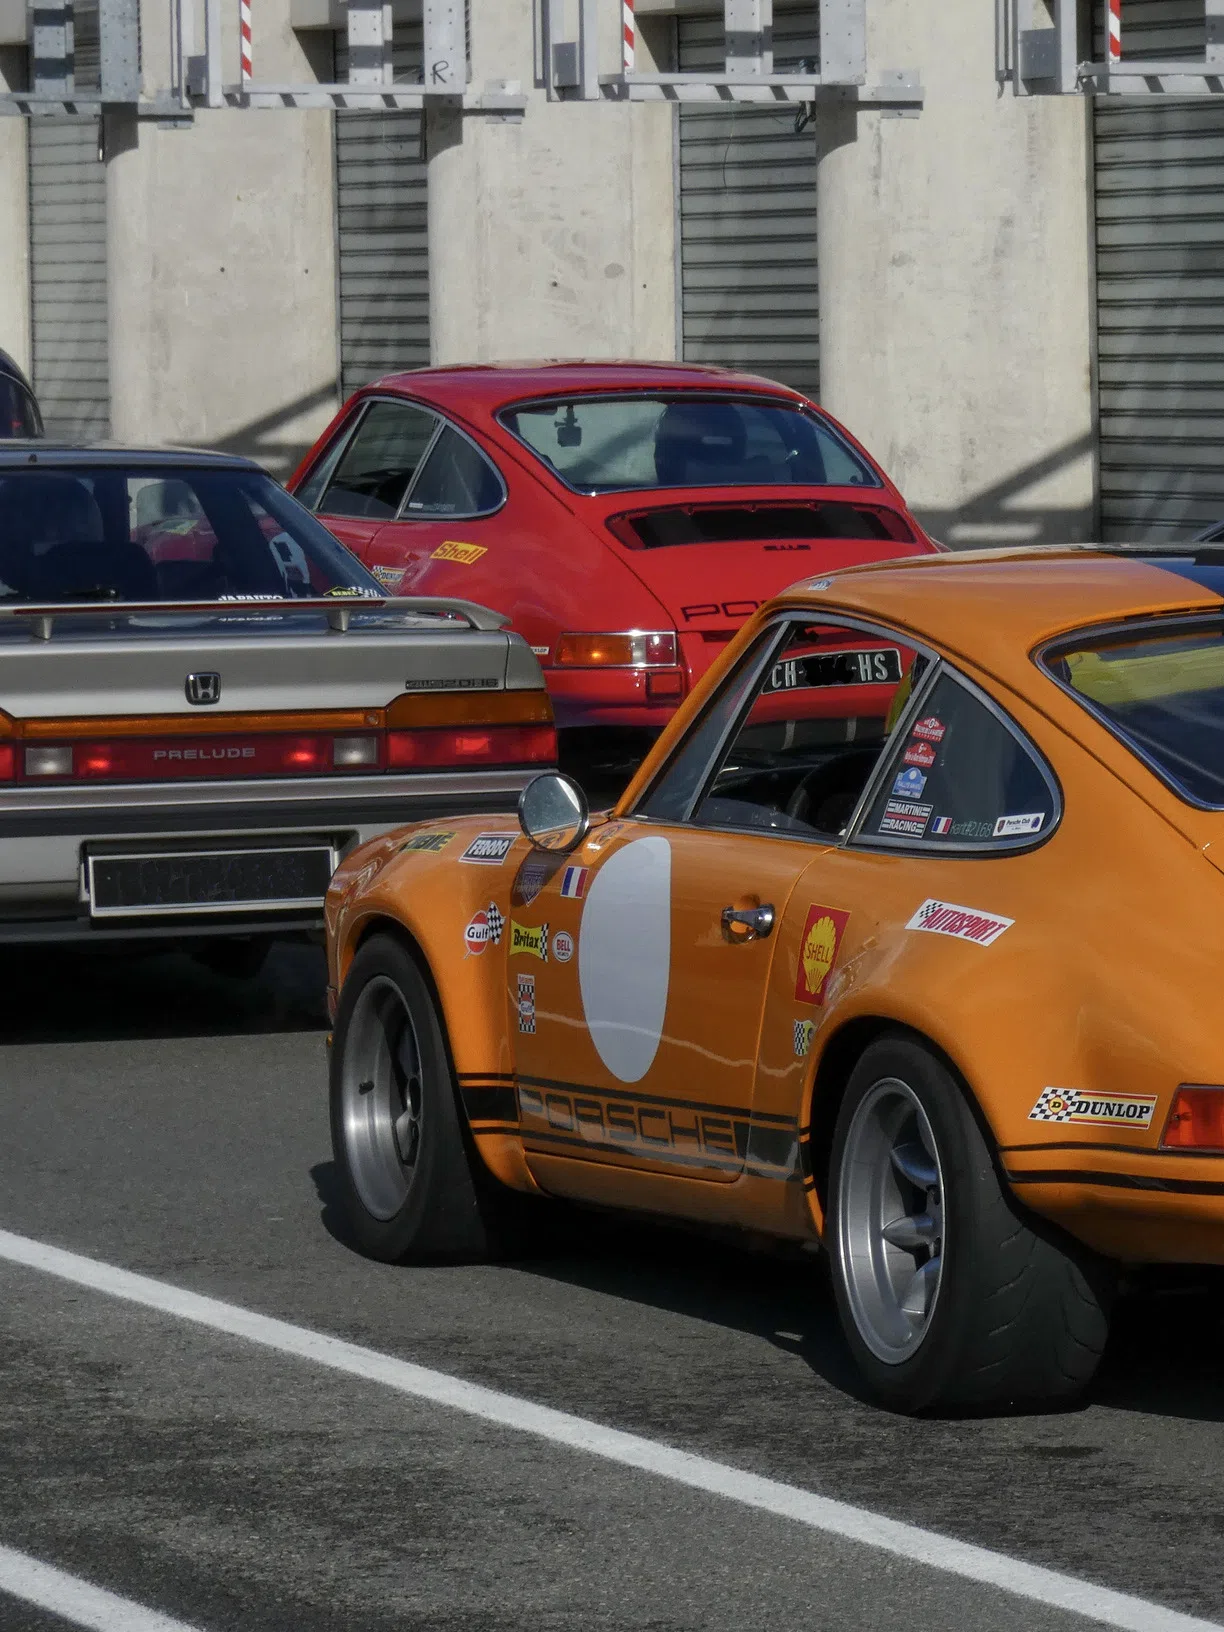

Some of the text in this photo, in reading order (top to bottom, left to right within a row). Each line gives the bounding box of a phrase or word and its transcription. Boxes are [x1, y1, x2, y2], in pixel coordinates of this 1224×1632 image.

[436, 545, 484, 563] Shell
[153, 747, 256, 761] PRELUDE
[894, 802, 923, 817] MARTINI
[889, 819, 918, 832] RACING
[468, 839, 509, 856] FERODO
[467, 926, 489, 939] Gulf
[918, 907, 1009, 942] AUTOSPORT
[513, 928, 540, 949] Britax
[556, 939, 571, 952] BELL
[806, 943, 831, 964] SHELL
[1074, 1100, 1151, 1119] DUNLOP
[519, 1086, 737, 1157] PORSCHE
